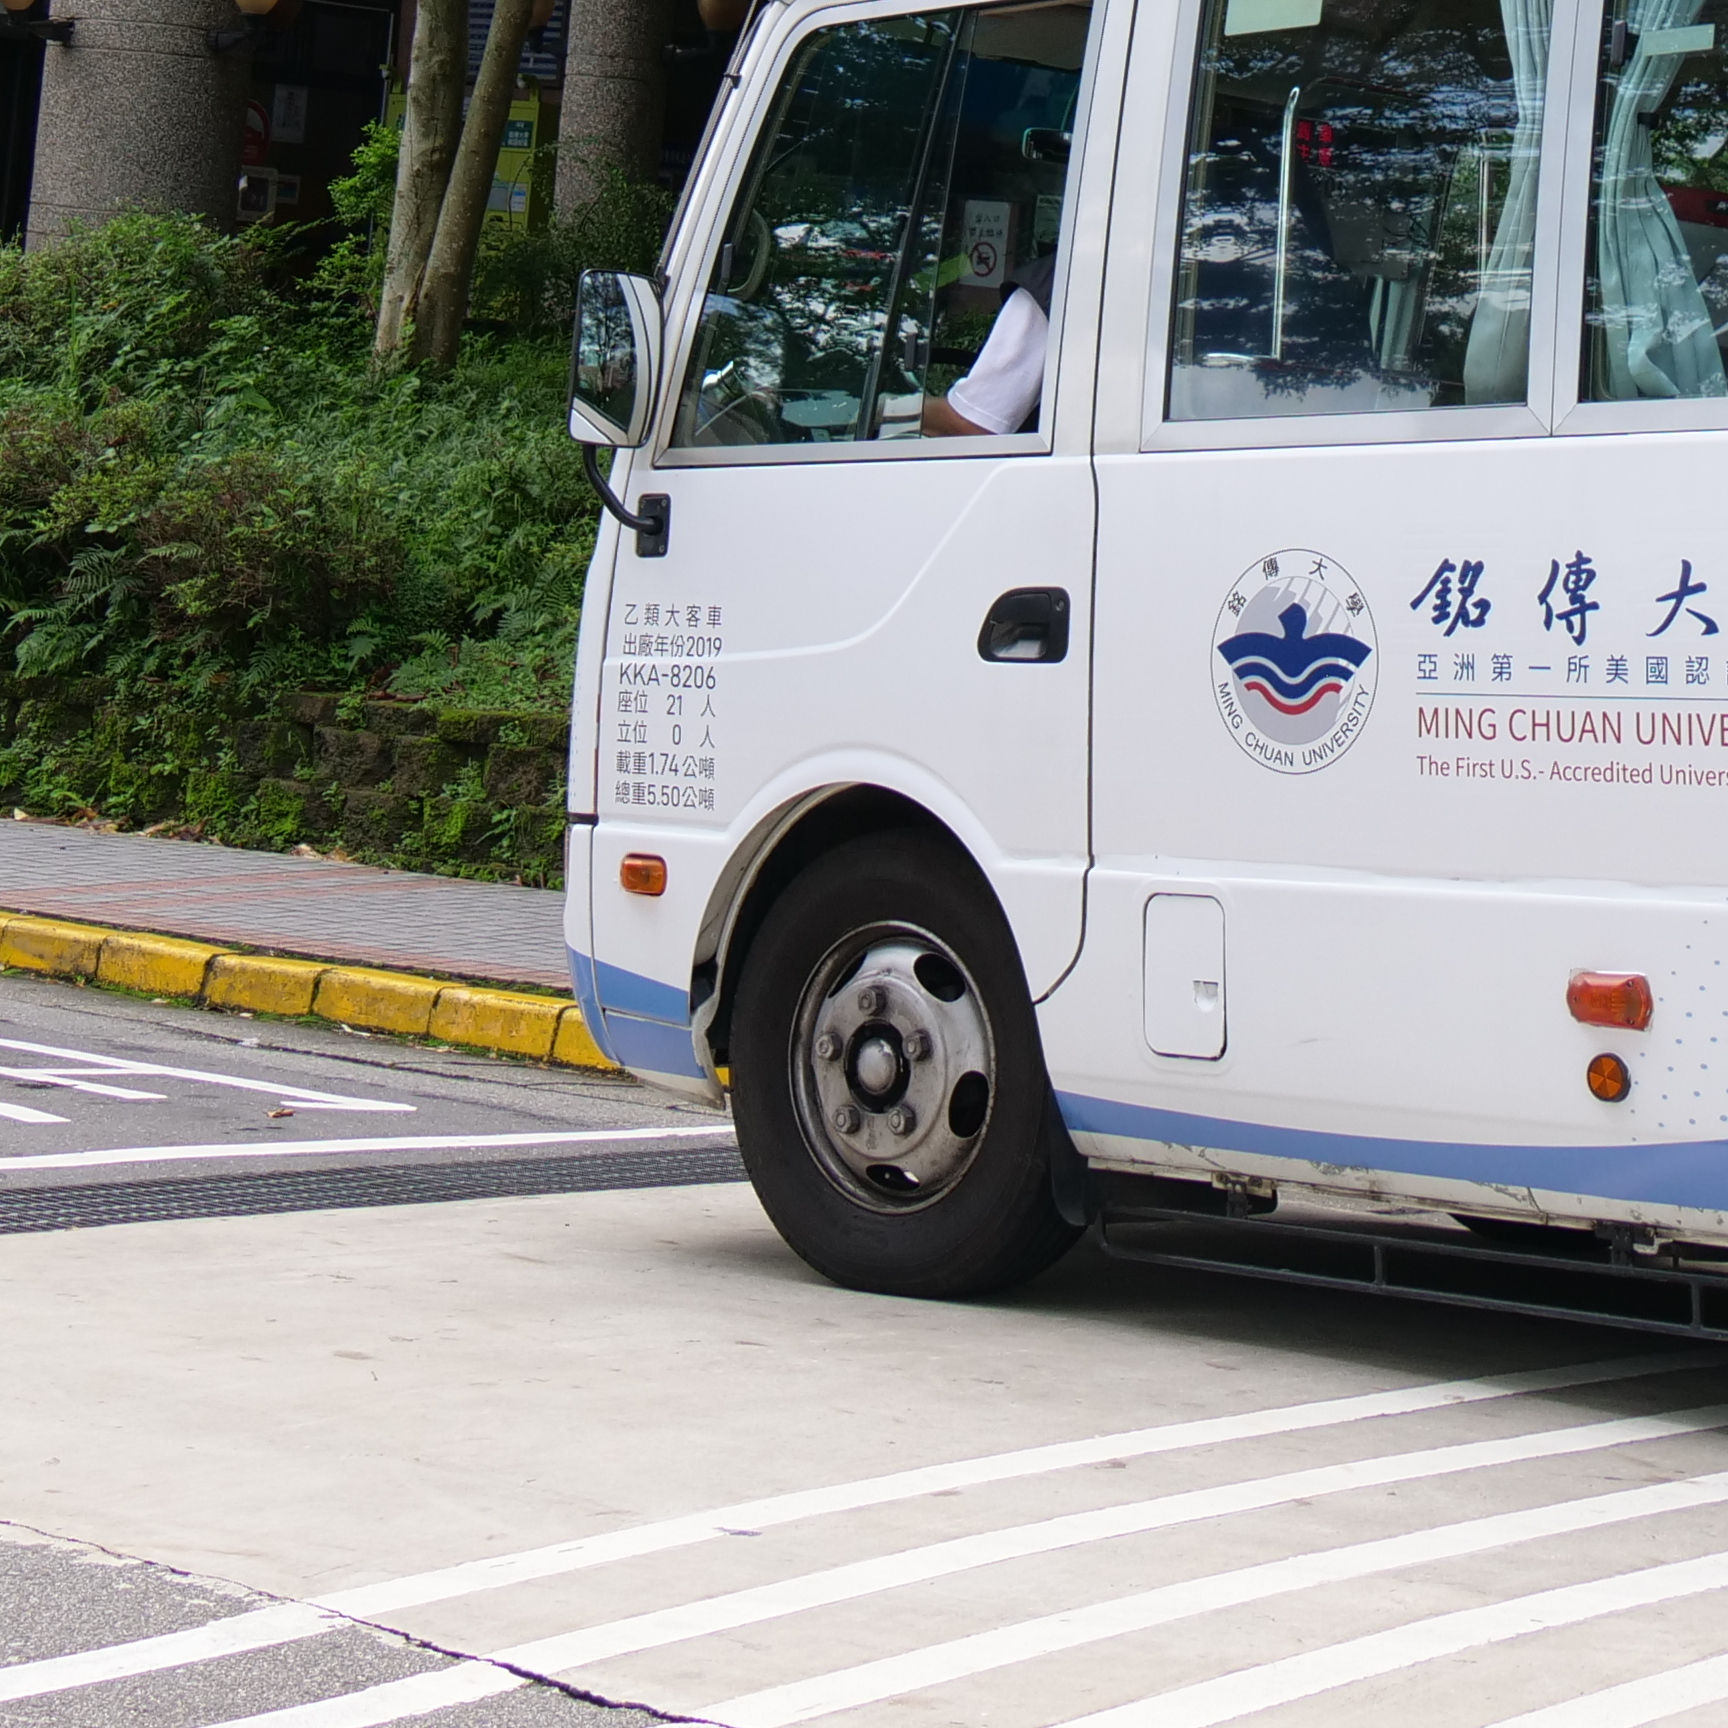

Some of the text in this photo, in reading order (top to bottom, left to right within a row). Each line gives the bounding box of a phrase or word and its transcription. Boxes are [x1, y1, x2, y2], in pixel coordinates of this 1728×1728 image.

[1227, 557, 1364, 617] 銘傳大學
[624, 602, 722, 629] 乙類大客車
[619, 662, 716, 689] KKA-8206
[617, 688, 716, 718] 座位 21 人
[616, 719, 715, 749] 立位 0 人
[1218, 681, 1370, 766] MING CHUAN UNIVERSITY
[1417, 706, 1497, 741] MING
[1508, 708, 1621, 744] CHUAN
[1416, 755, 1450, 776] The
[1456, 757, 1495, 779] First
[1549, 760, 1652, 784] Accredited
